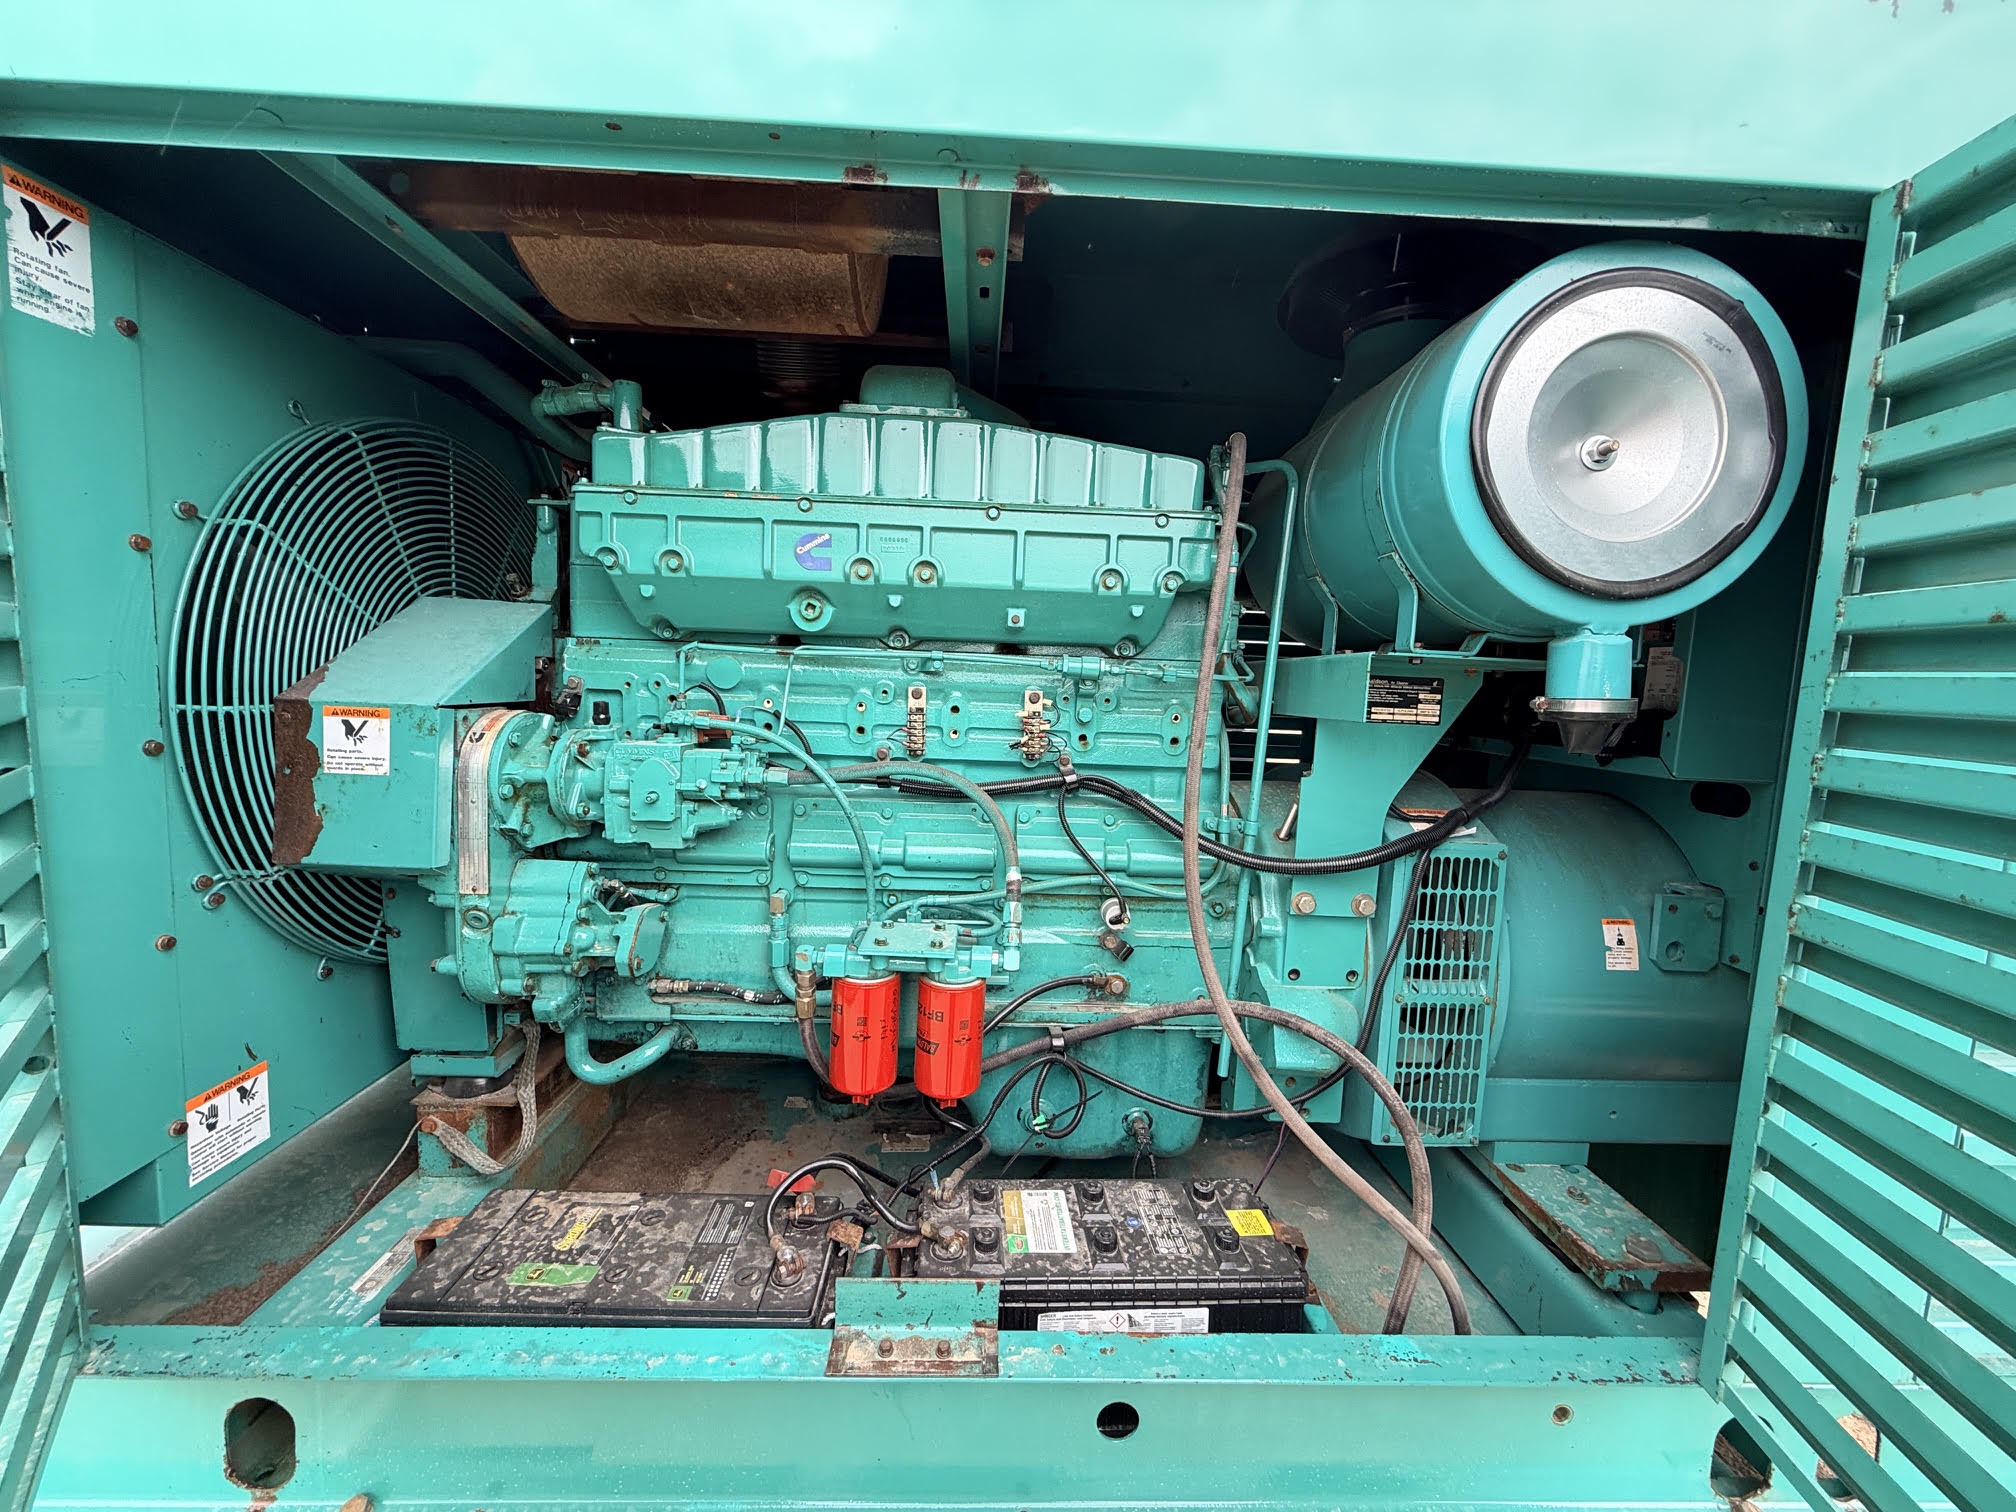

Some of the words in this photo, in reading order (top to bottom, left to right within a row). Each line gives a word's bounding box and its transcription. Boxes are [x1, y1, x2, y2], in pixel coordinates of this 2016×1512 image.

[21, 180, 84, 218] WARNING
[13, 247, 51, 269] Rotating
[54, 265, 71, 277] fan.
[14, 256, 32, 268] Can
[35, 266, 60, 281] cause
[63, 279, 91, 294] severe
[15, 276, 37, 291] Stay
[65, 298, 74, 306] of
[76, 302, 90, 312] fan
[44, 298, 73, 314] engine
[796, 533, 831, 555] Cummins
[340, 708, 380, 718] WARNING
[211, 1072, 251, 1098] WARNING
